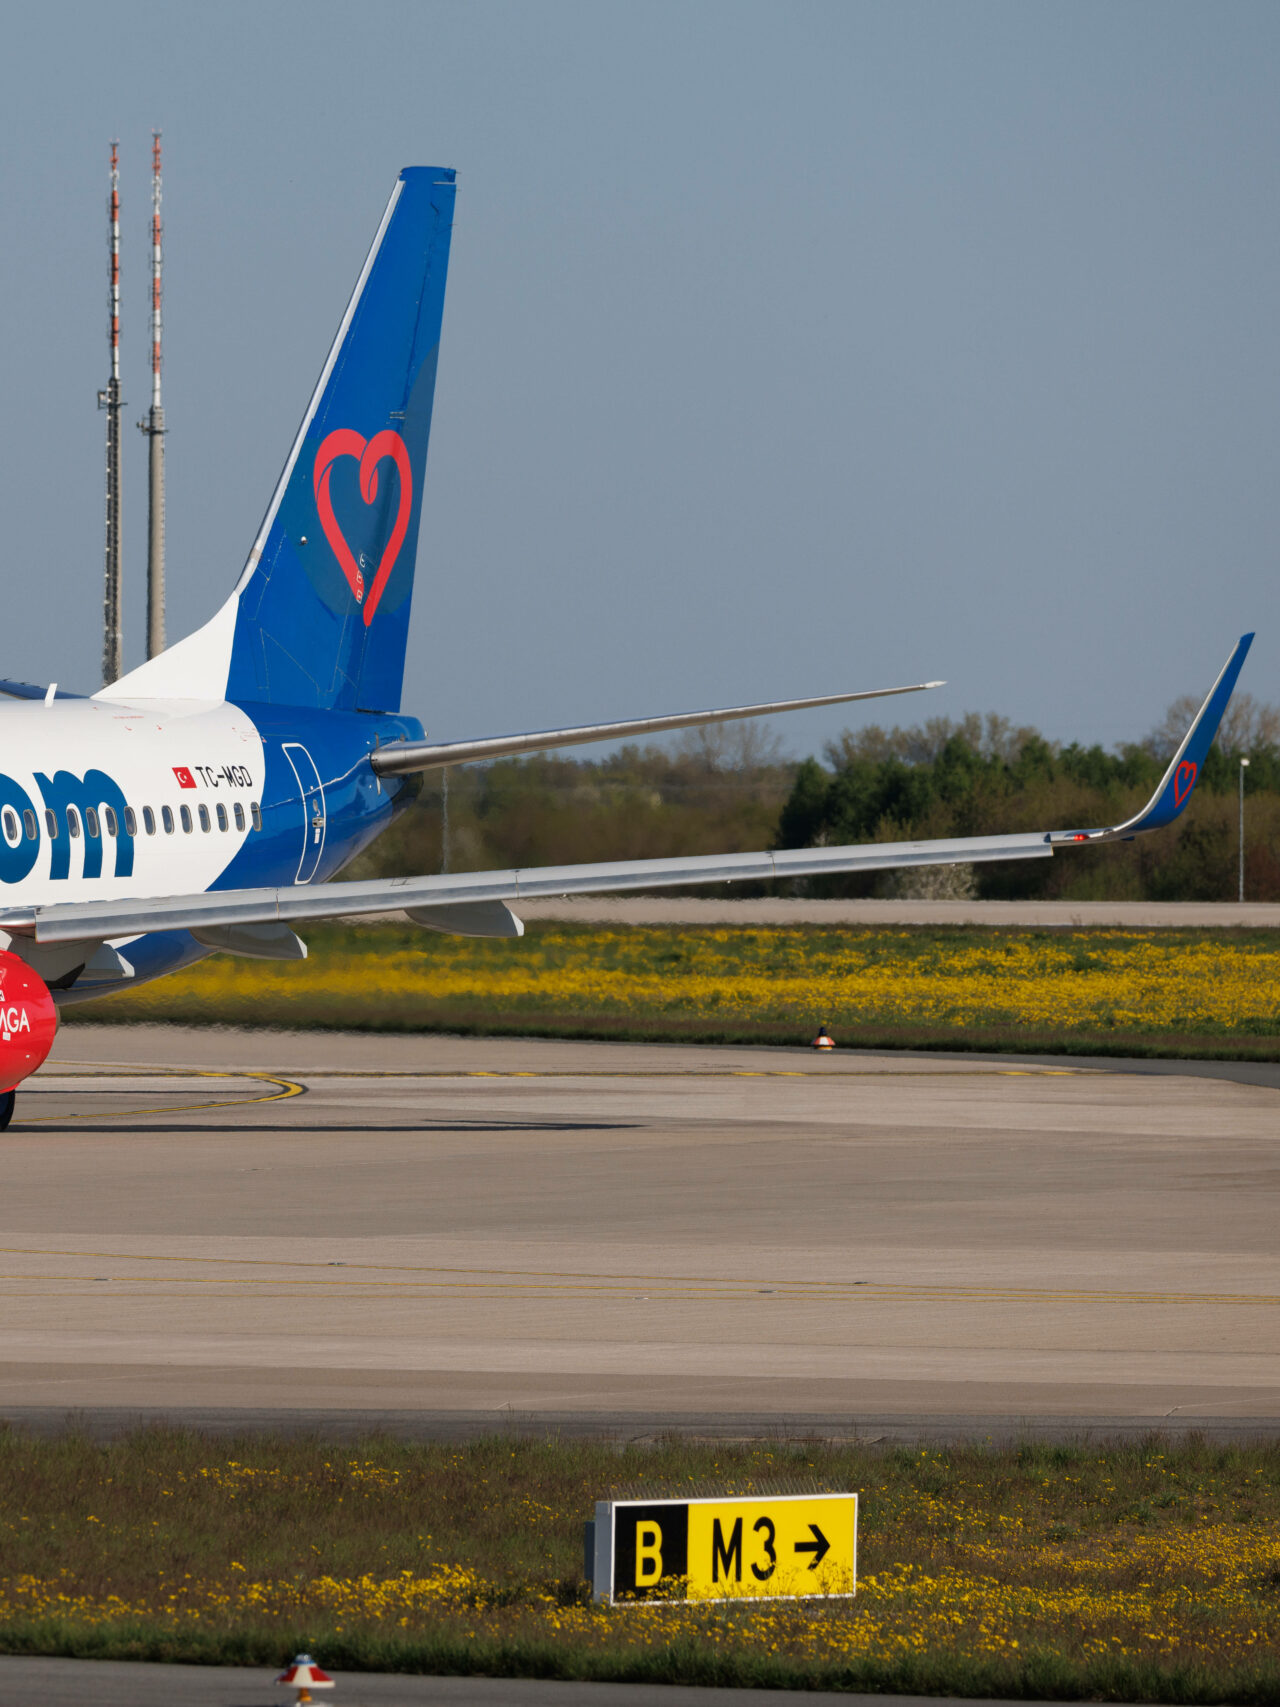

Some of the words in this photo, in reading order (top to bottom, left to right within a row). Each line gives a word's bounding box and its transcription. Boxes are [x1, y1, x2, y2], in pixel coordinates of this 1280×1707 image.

[194, 765, 253, 788] TC-MGD
[635, 1520, 663, 1588] B
[712, 1516, 776, 1583] M3
